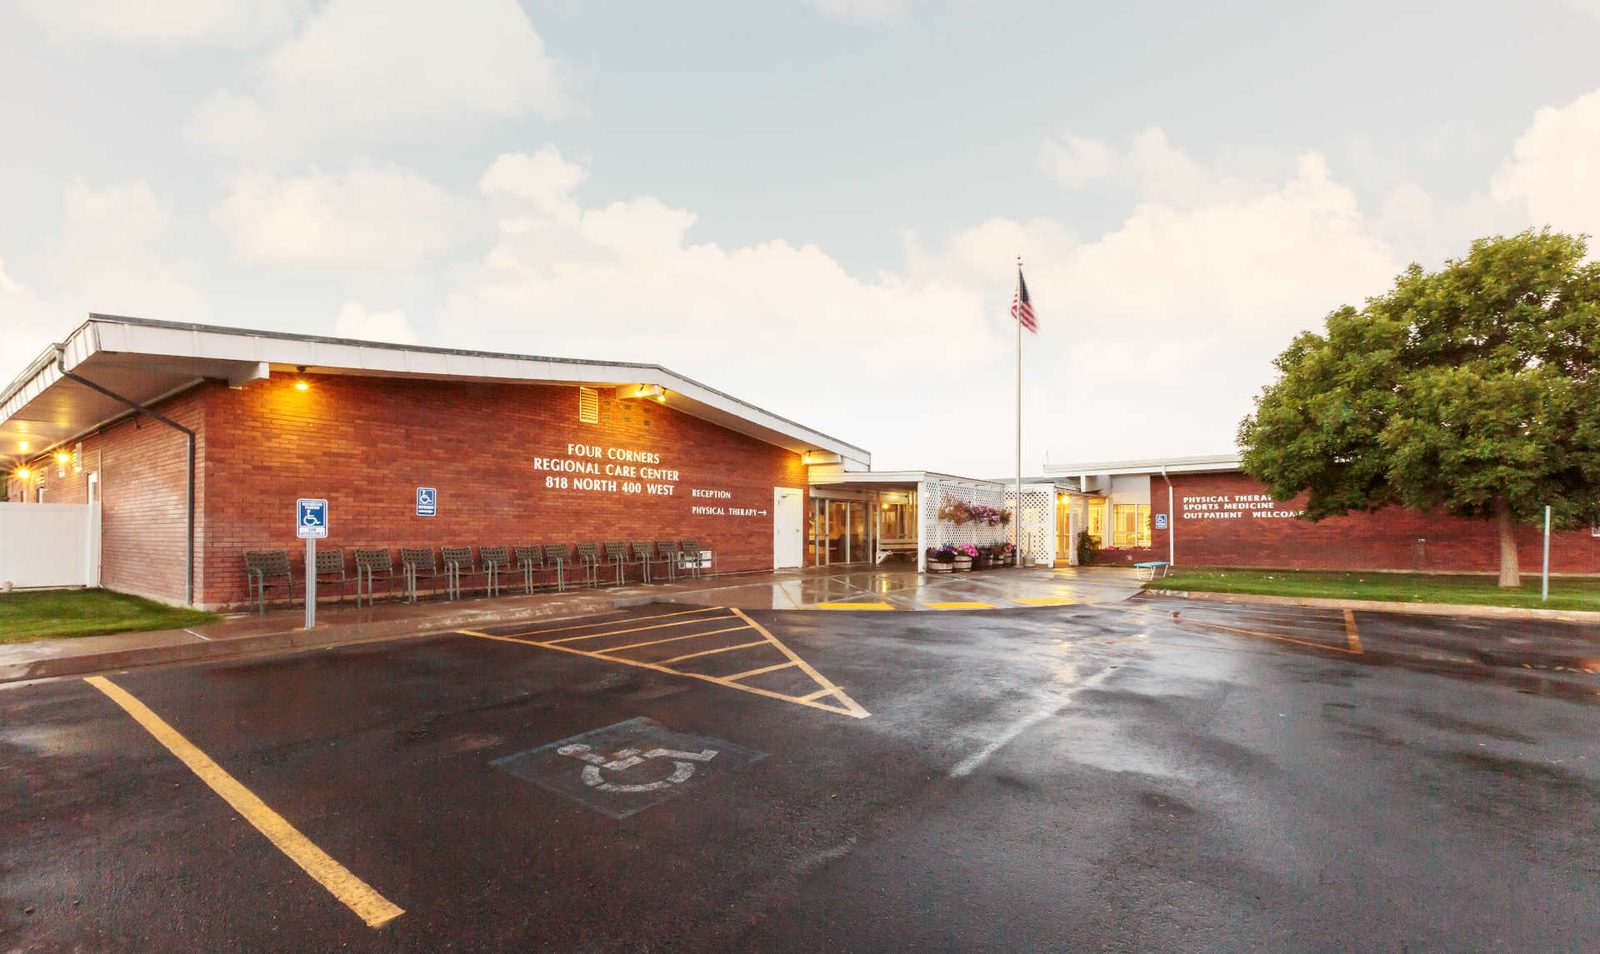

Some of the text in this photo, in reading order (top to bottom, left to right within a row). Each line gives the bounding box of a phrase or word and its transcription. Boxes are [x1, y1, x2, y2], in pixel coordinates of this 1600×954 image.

[567, 443, 660, 465] FOUR CORNERS
[533, 457, 680, 482] REGIONAL CARE CENTER
[545, 476, 675, 496] 818 NORTH 400 WEST
[691, 488, 731, 499] RECEPTION
[691, 506, 758, 517] PHYSICAL THERAPY
[1183, 502, 1275, 511] SPORTS MEDICINE
[1183, 511, 1243, 519] OUTPATIENT
